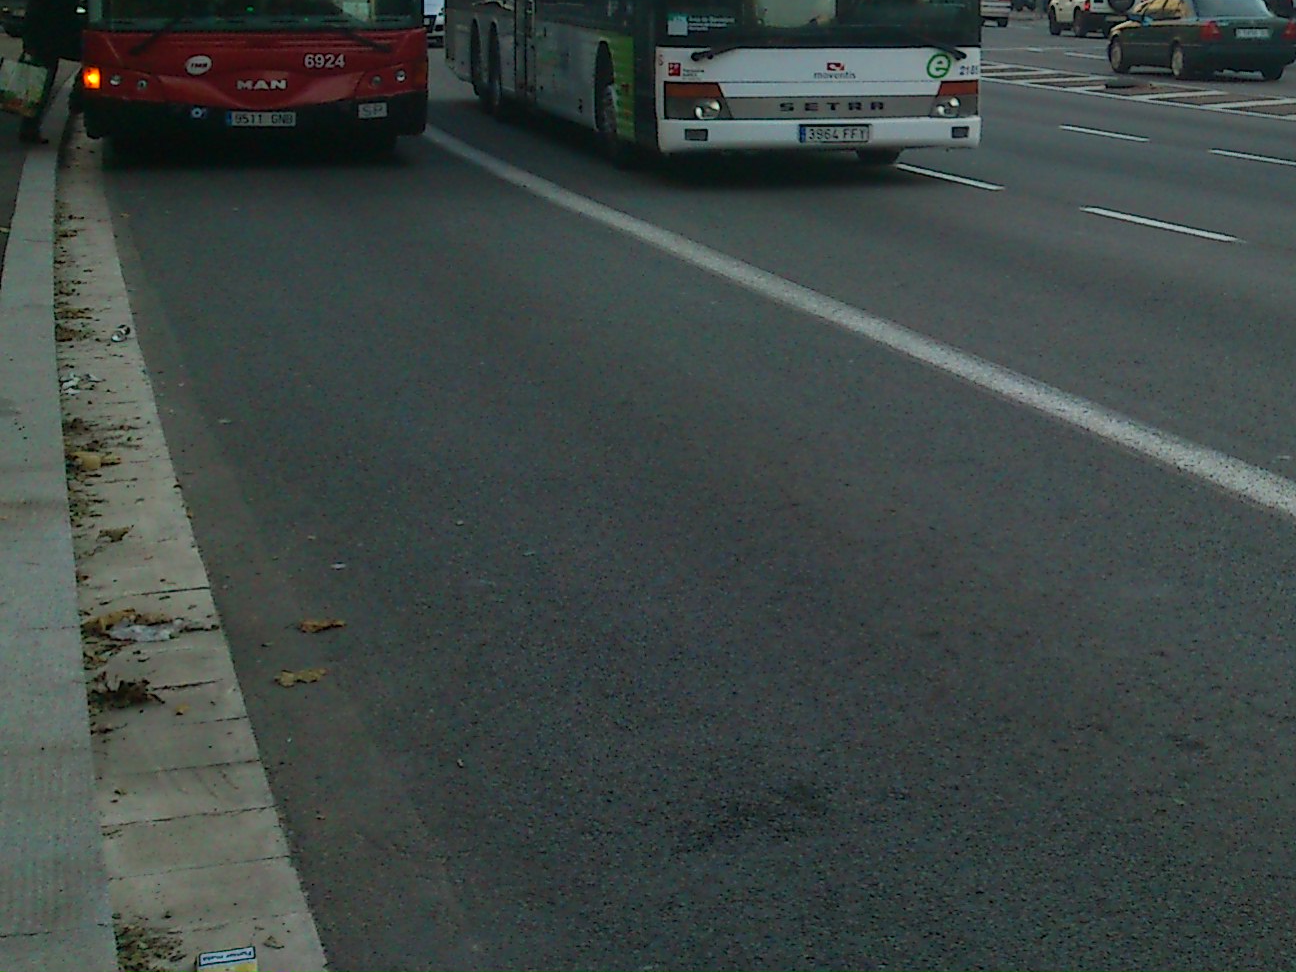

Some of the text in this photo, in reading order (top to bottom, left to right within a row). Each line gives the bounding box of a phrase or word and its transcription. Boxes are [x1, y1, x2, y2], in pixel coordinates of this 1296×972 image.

[304, 53, 346, 69] 6924
[236, 79, 288, 90] MAN
[362, 105, 383, 117] SP
[780, 101, 884, 112] SETRA
